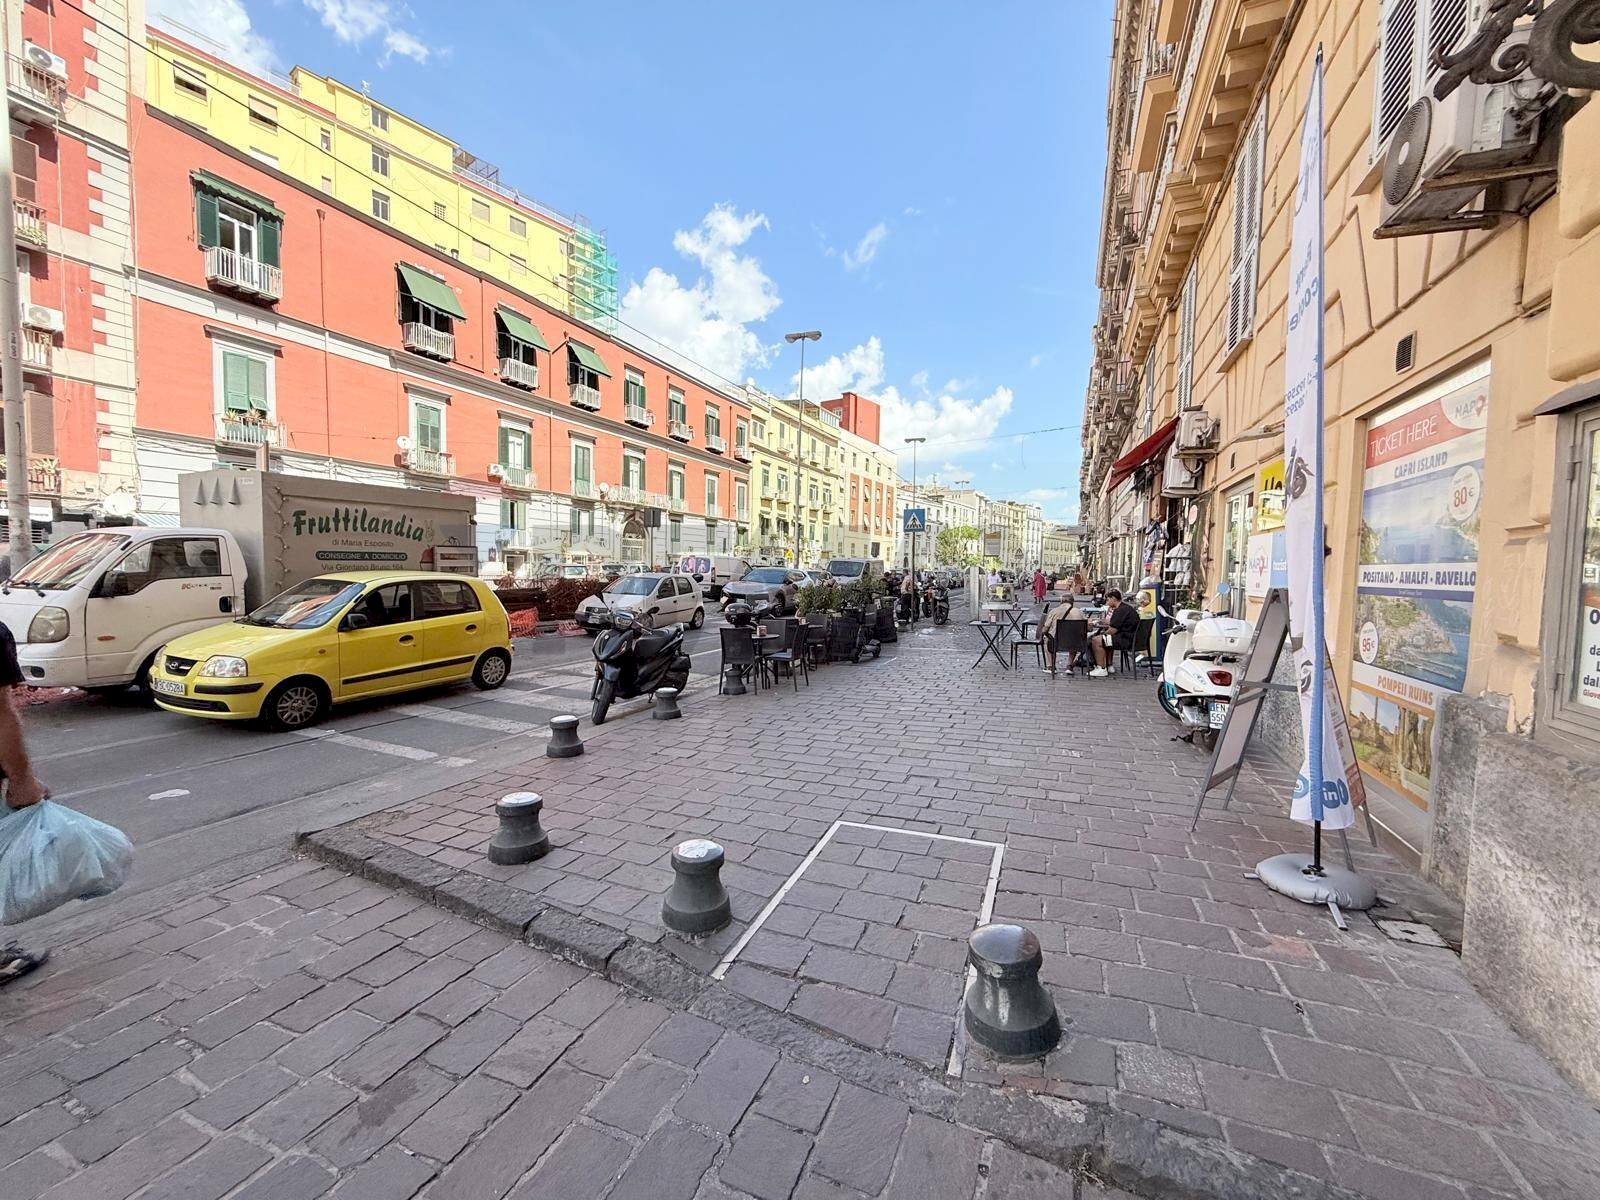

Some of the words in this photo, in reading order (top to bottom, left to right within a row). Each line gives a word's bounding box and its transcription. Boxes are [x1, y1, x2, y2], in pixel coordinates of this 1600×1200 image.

[1371, 428, 1405, 458] TICKET
[1406, 415, 1439, 444] HERE
[1394, 460, 1415, 478] CAPRI
[1417, 451, 1448, 472] ISLAND
[292, 507, 424, 541] Fruttilandia
[364, 540, 395, 549] Esposito
[319, 552, 361, 560] CONSEGNE
[321, 562, 334, 571] Via
[1362, 571, 1395, 584] POSITANO
[1399, 570, 1429, 585] AMALFI
[1434, 570, 1477, 587] RAVELLO
[1377, 675, 1408, 697] POMPEII
[1408, 685, 1434, 706] RUINS
